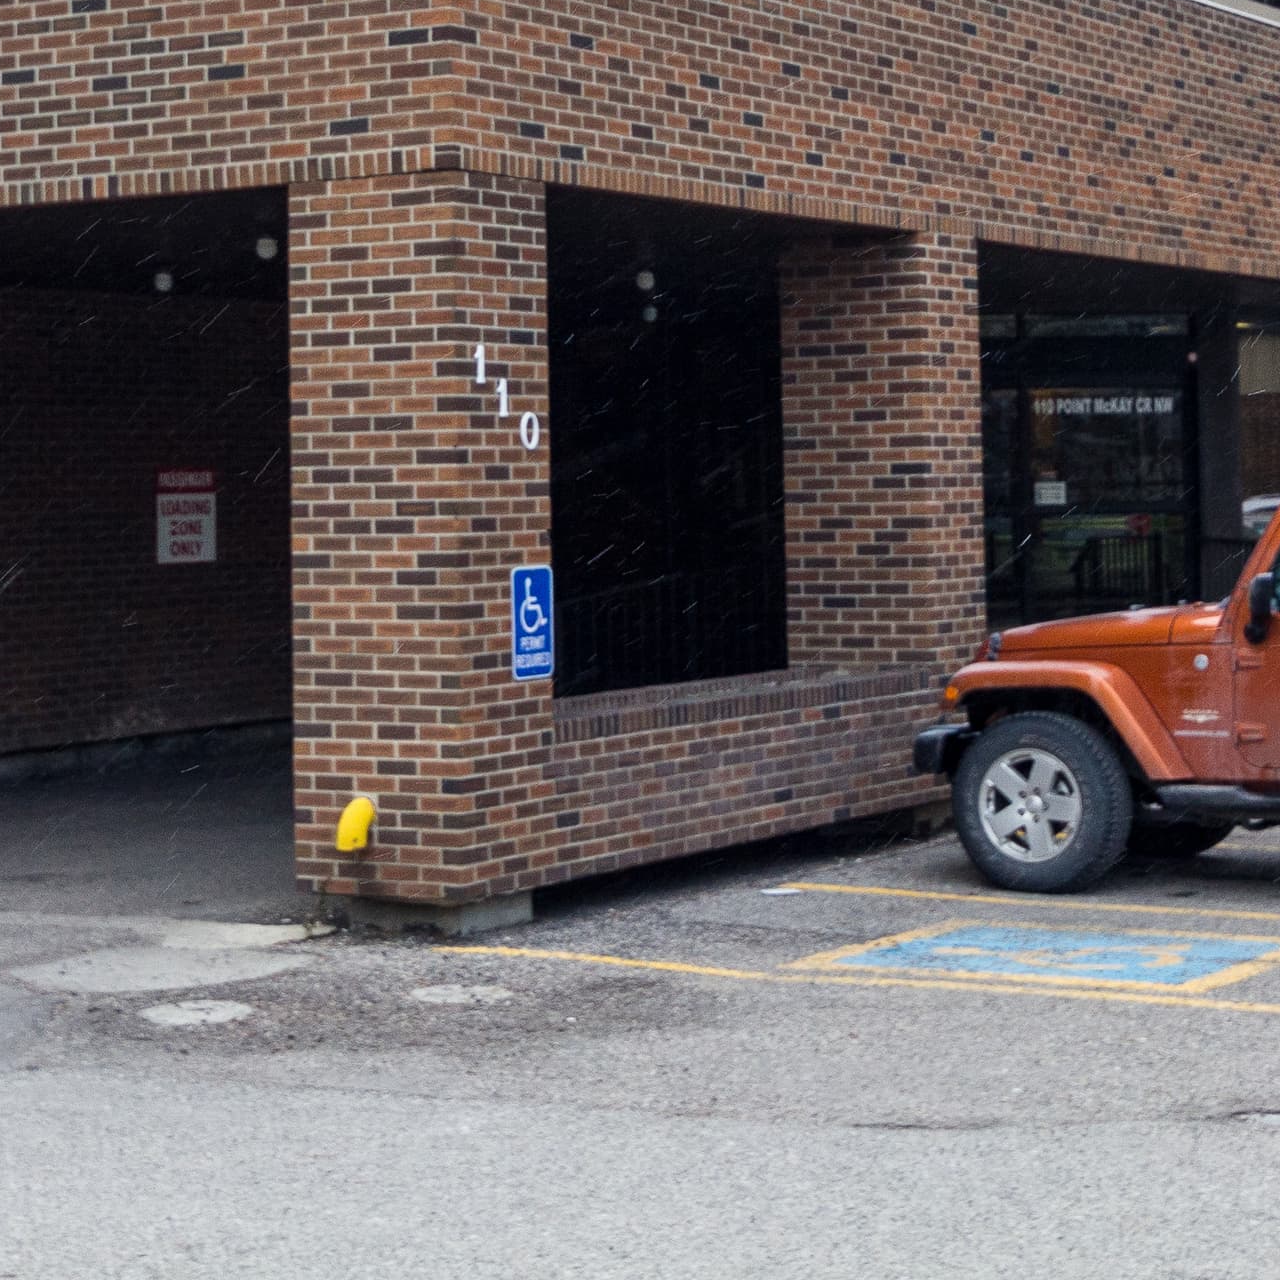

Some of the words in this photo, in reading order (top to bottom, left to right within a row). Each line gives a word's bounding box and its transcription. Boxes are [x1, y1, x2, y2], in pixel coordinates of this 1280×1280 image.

[1056, 397, 1091, 414] POINT
[1135, 397, 1152, 412] CR
[1154, 396, 1173, 412] NW
[160, 499, 211, 516] LOADING
[170, 521, 202, 536] ZONE
[170, 540, 203, 556] ONLY
